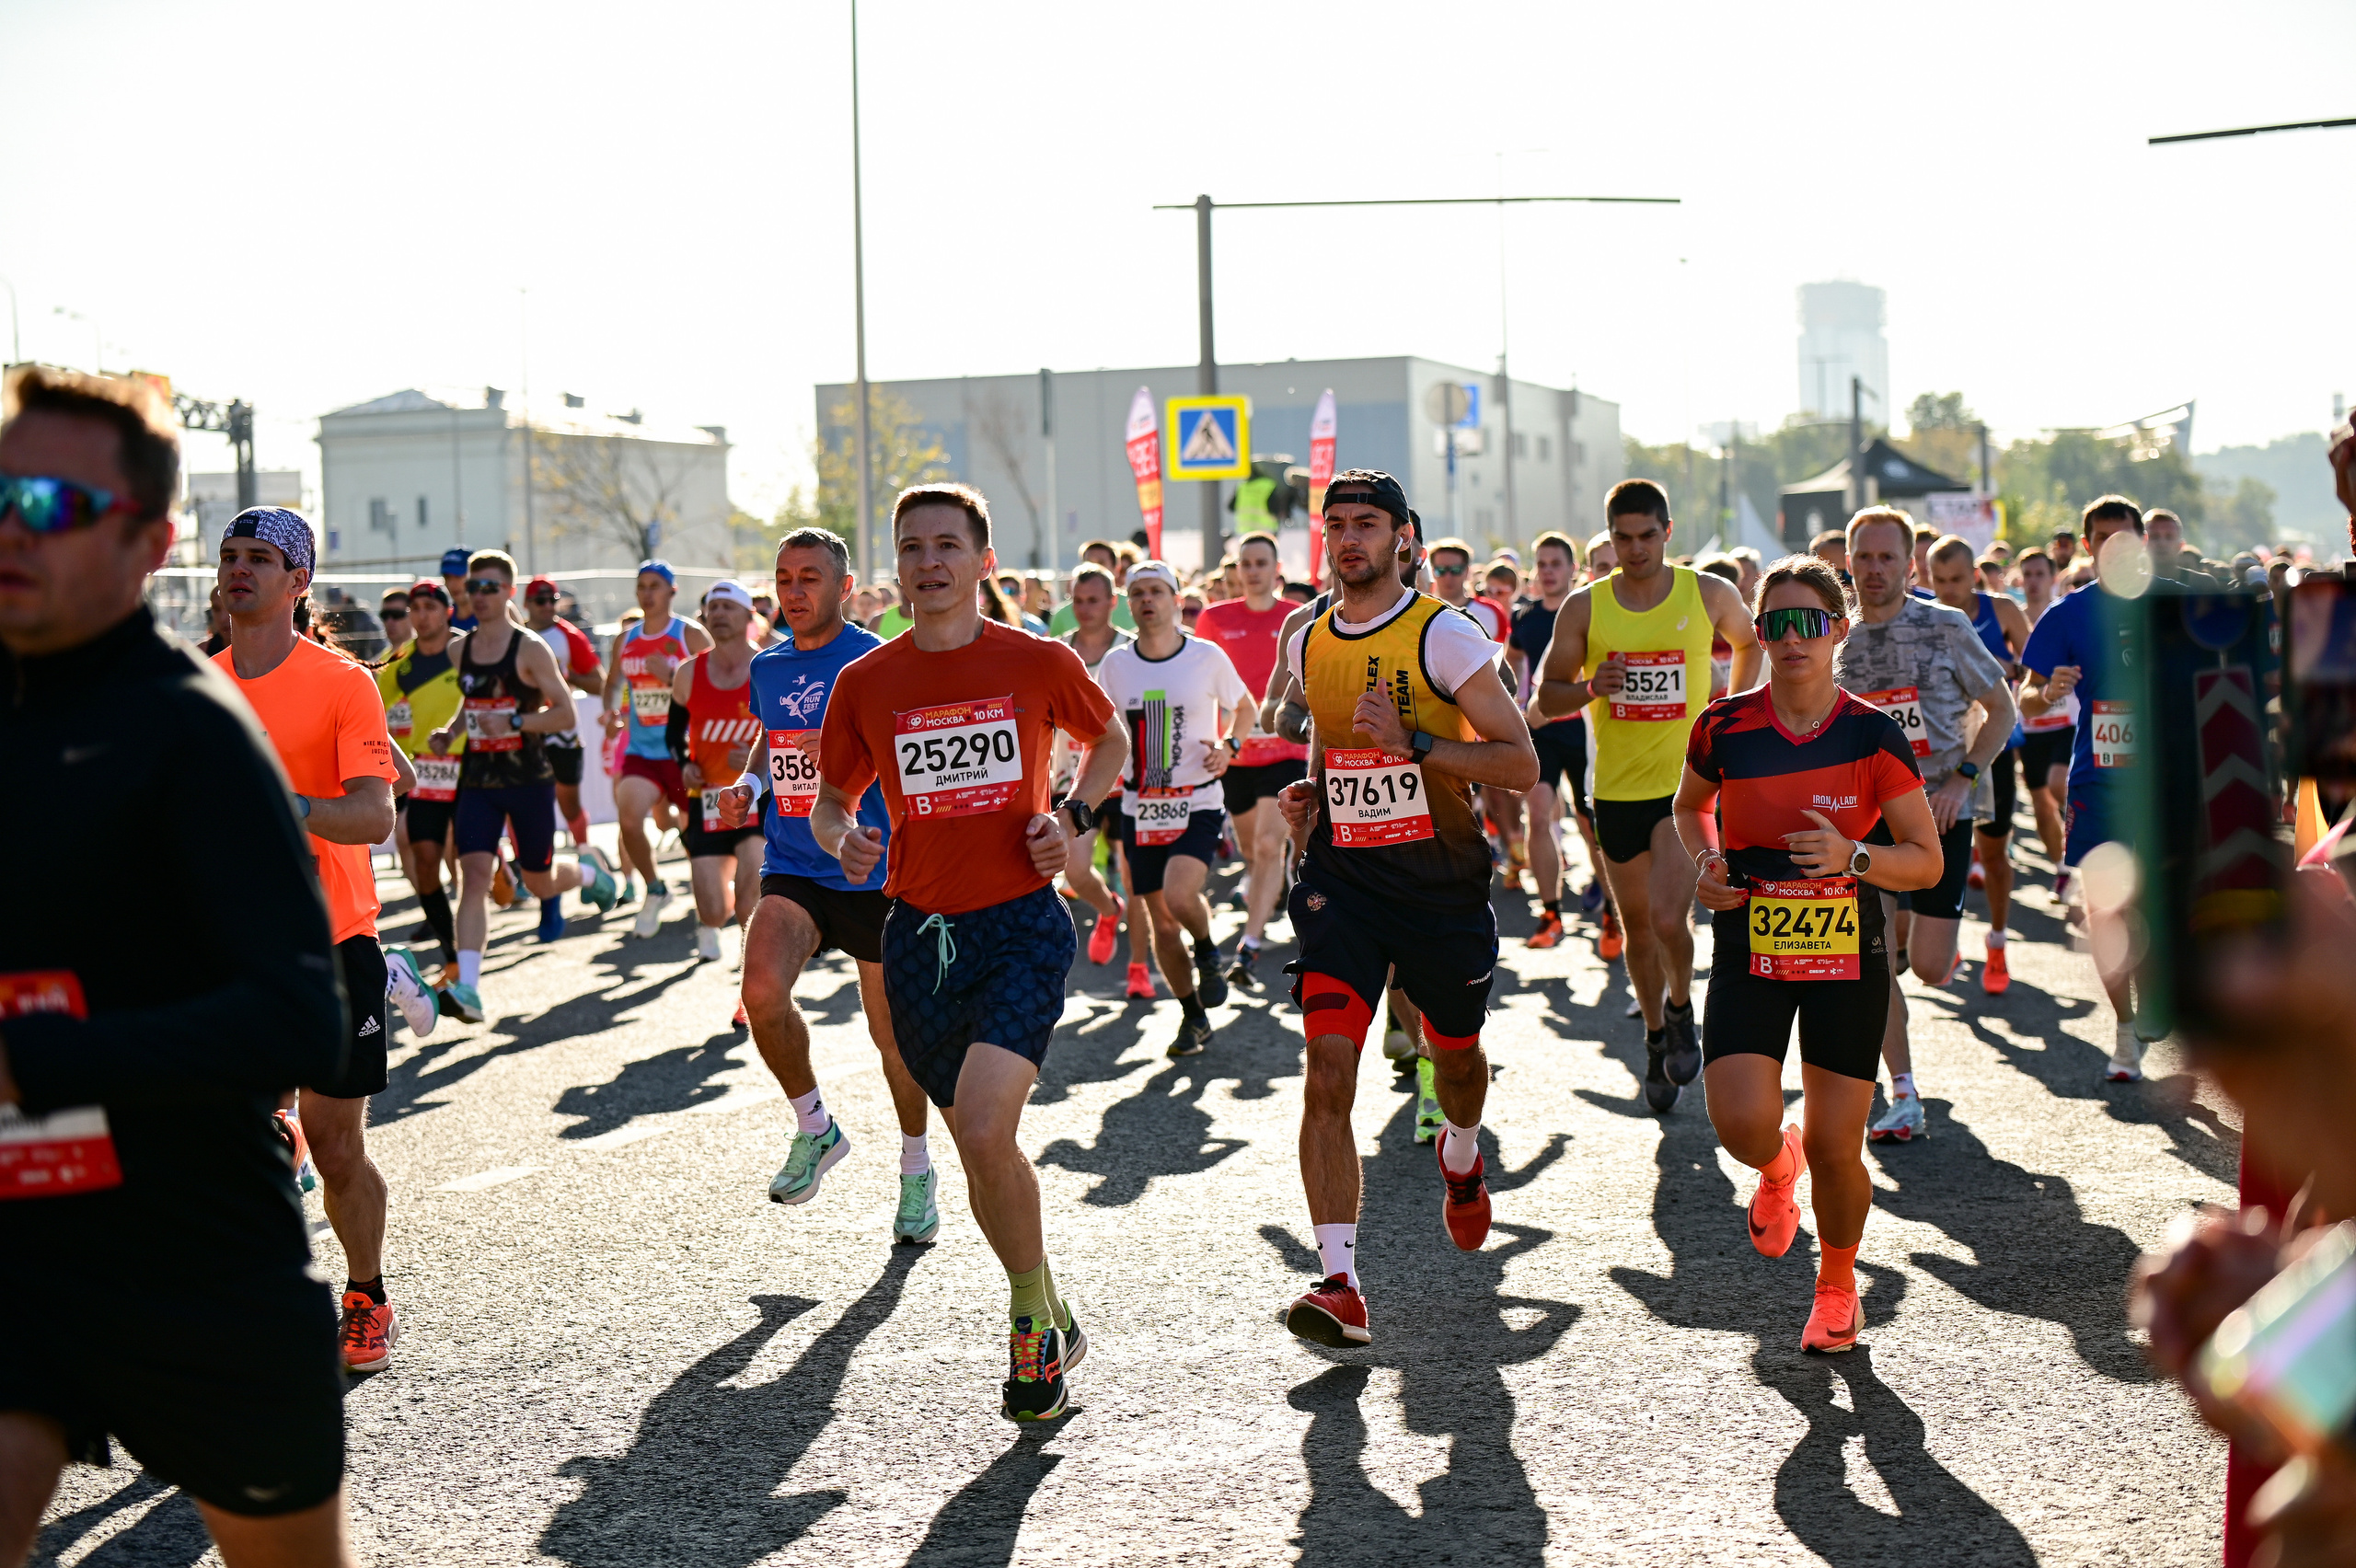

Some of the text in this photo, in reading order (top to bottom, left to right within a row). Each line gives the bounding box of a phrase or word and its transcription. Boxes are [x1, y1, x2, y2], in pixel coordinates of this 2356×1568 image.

[1621, 670, 1680, 693] 5521
[1396, 669, 1412, 717] TEAM
[1625, 694, 1669, 702] ВЛАДИСЛАВ
[803, 696, 821, 704] RUN
[925, 707, 972, 719] МАРАФОН
[926, 716, 965, 728] МОСКВА
[974, 711, 986, 721] 10
[987, 709, 1005, 719] КМ
[902, 730, 1015, 776] 25290
[1382, 755, 1393, 765] 10
[935, 767, 988, 787] ДМИТРИЙ
[791, 782, 819, 791] ВИТАЛ
[1329, 772, 1418, 806] 37619
[1813, 794, 1857, 805] IRON LADY
[1138, 801, 1189, 820] 23868
[1358, 807, 1392, 818] ВАДИМ
[1779, 881, 1822, 889] МАРАФОН
[1823, 887, 1834, 896] 10
[1834, 886, 1848, 895] КМ
[1752, 905, 1855, 938] 32474
[1773, 940, 1832, 950] ЕЛИЗАВЕТА
[358, 1024, 381, 1037] adidas
